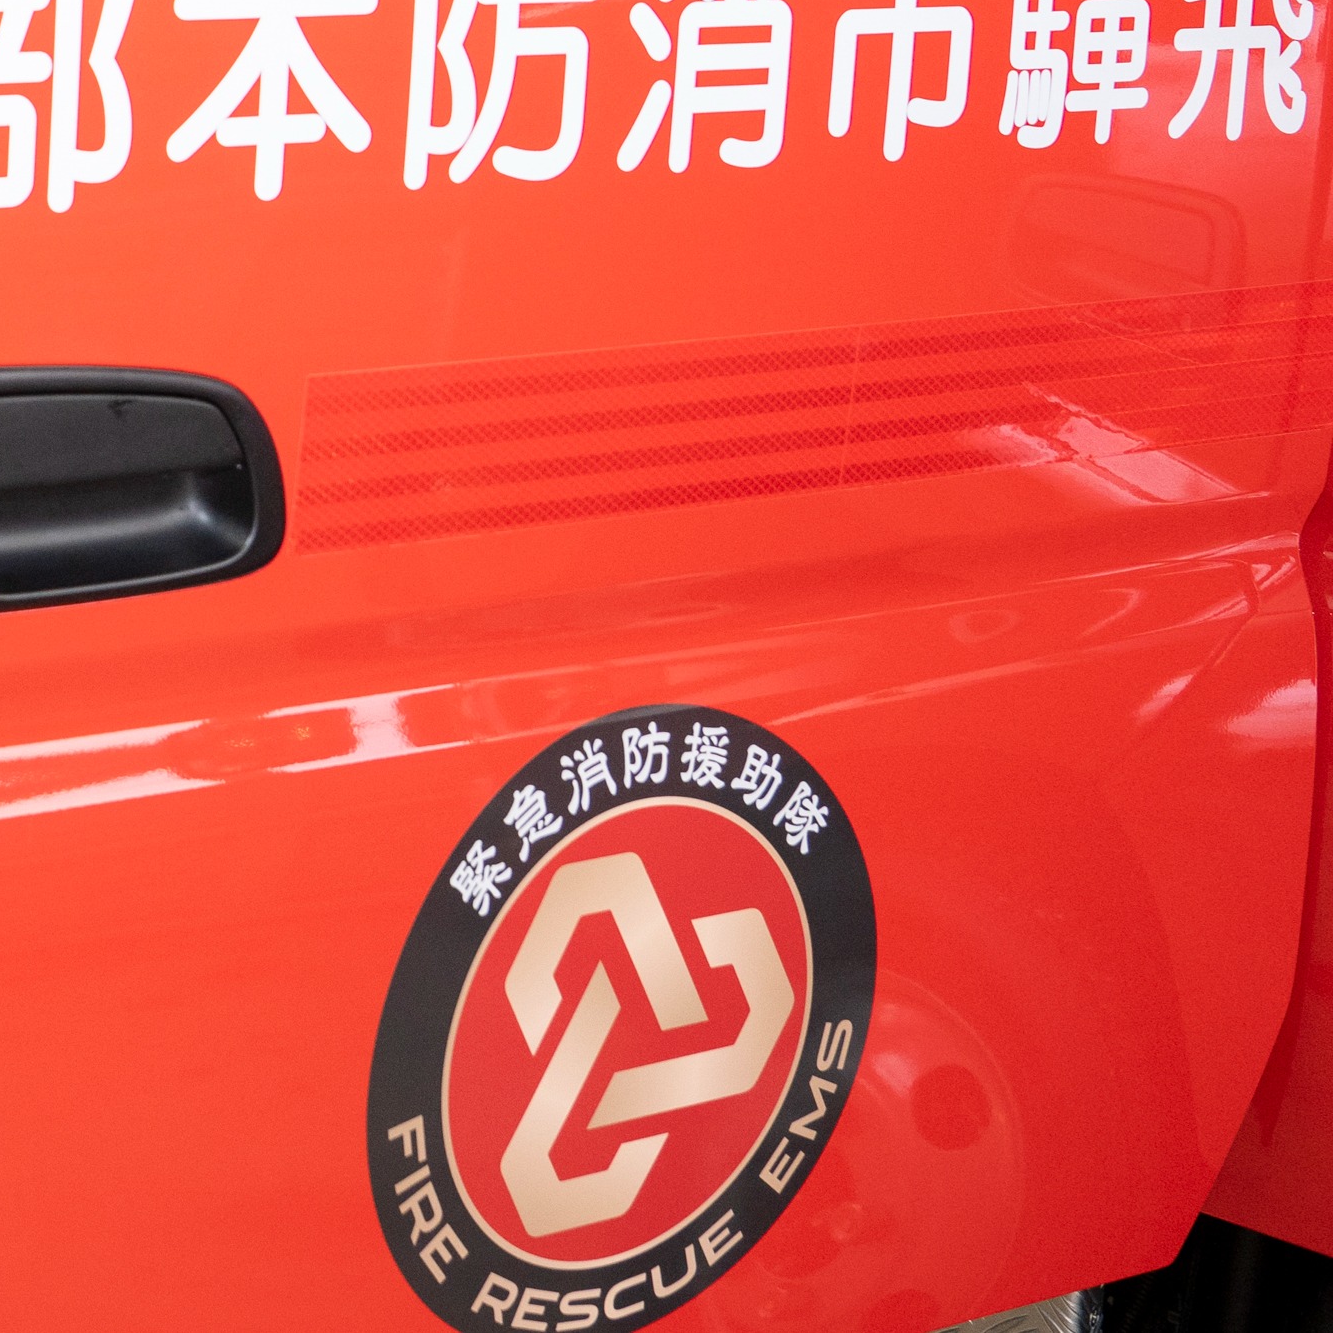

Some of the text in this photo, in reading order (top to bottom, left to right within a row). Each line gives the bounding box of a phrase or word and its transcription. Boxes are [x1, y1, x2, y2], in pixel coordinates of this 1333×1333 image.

[449, 721, 827, 917] 緊急消防援助隊
[388, 1019, 853, 1333] FIRE RESCUE EMS
